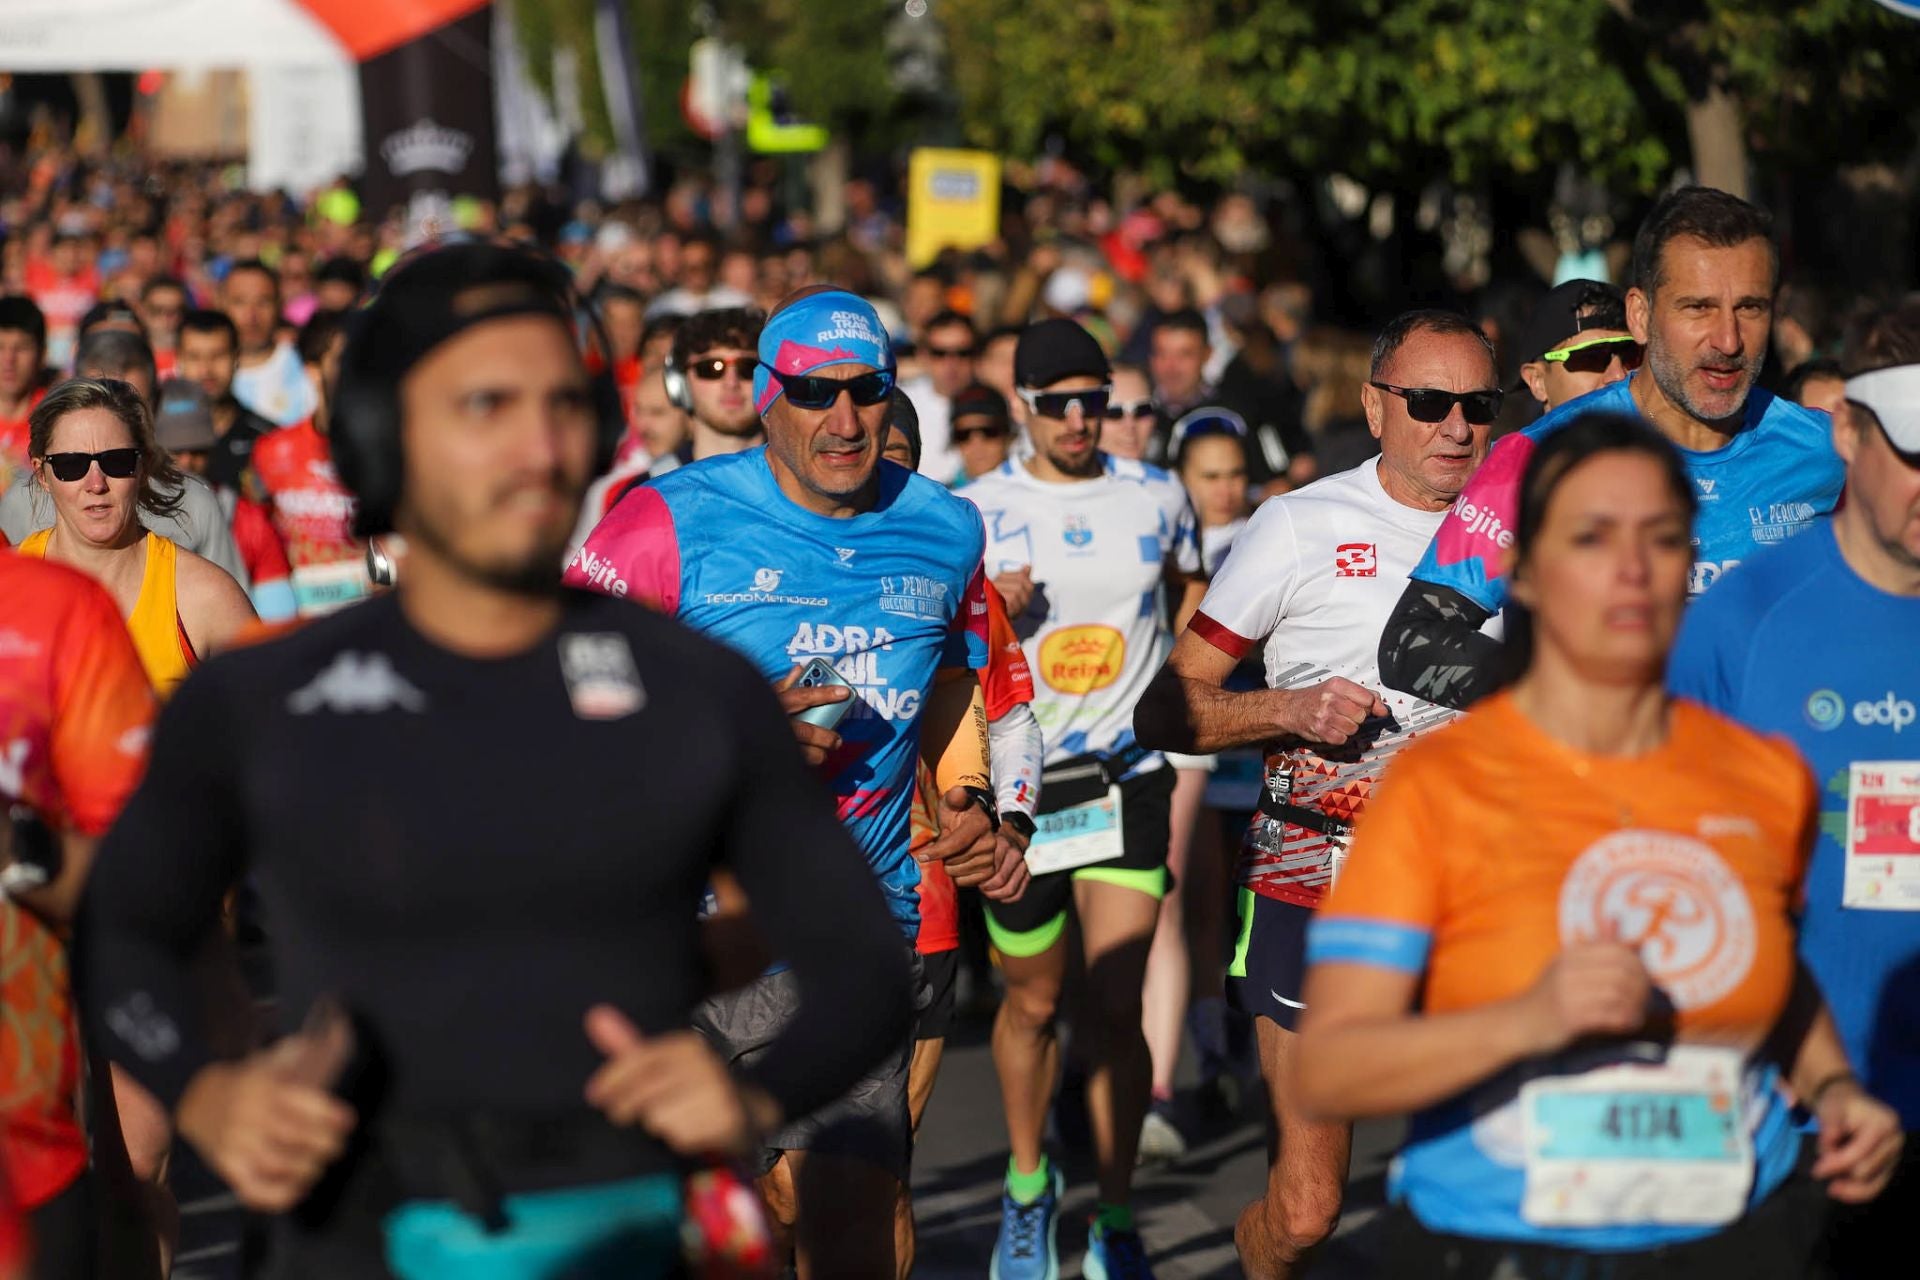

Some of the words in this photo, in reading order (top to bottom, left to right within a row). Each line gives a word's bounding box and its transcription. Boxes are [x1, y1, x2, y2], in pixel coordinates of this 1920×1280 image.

[831, 310, 869, 323] ADRA
[834, 318, 870, 333] TRAIL
[1452, 494, 1514, 549] Nejite
[569, 547, 628, 598] Nejite
[786, 622, 895, 655] ADRA
[1052, 662, 1111, 680] Reina
[1853, 691, 1916, 734] edp
